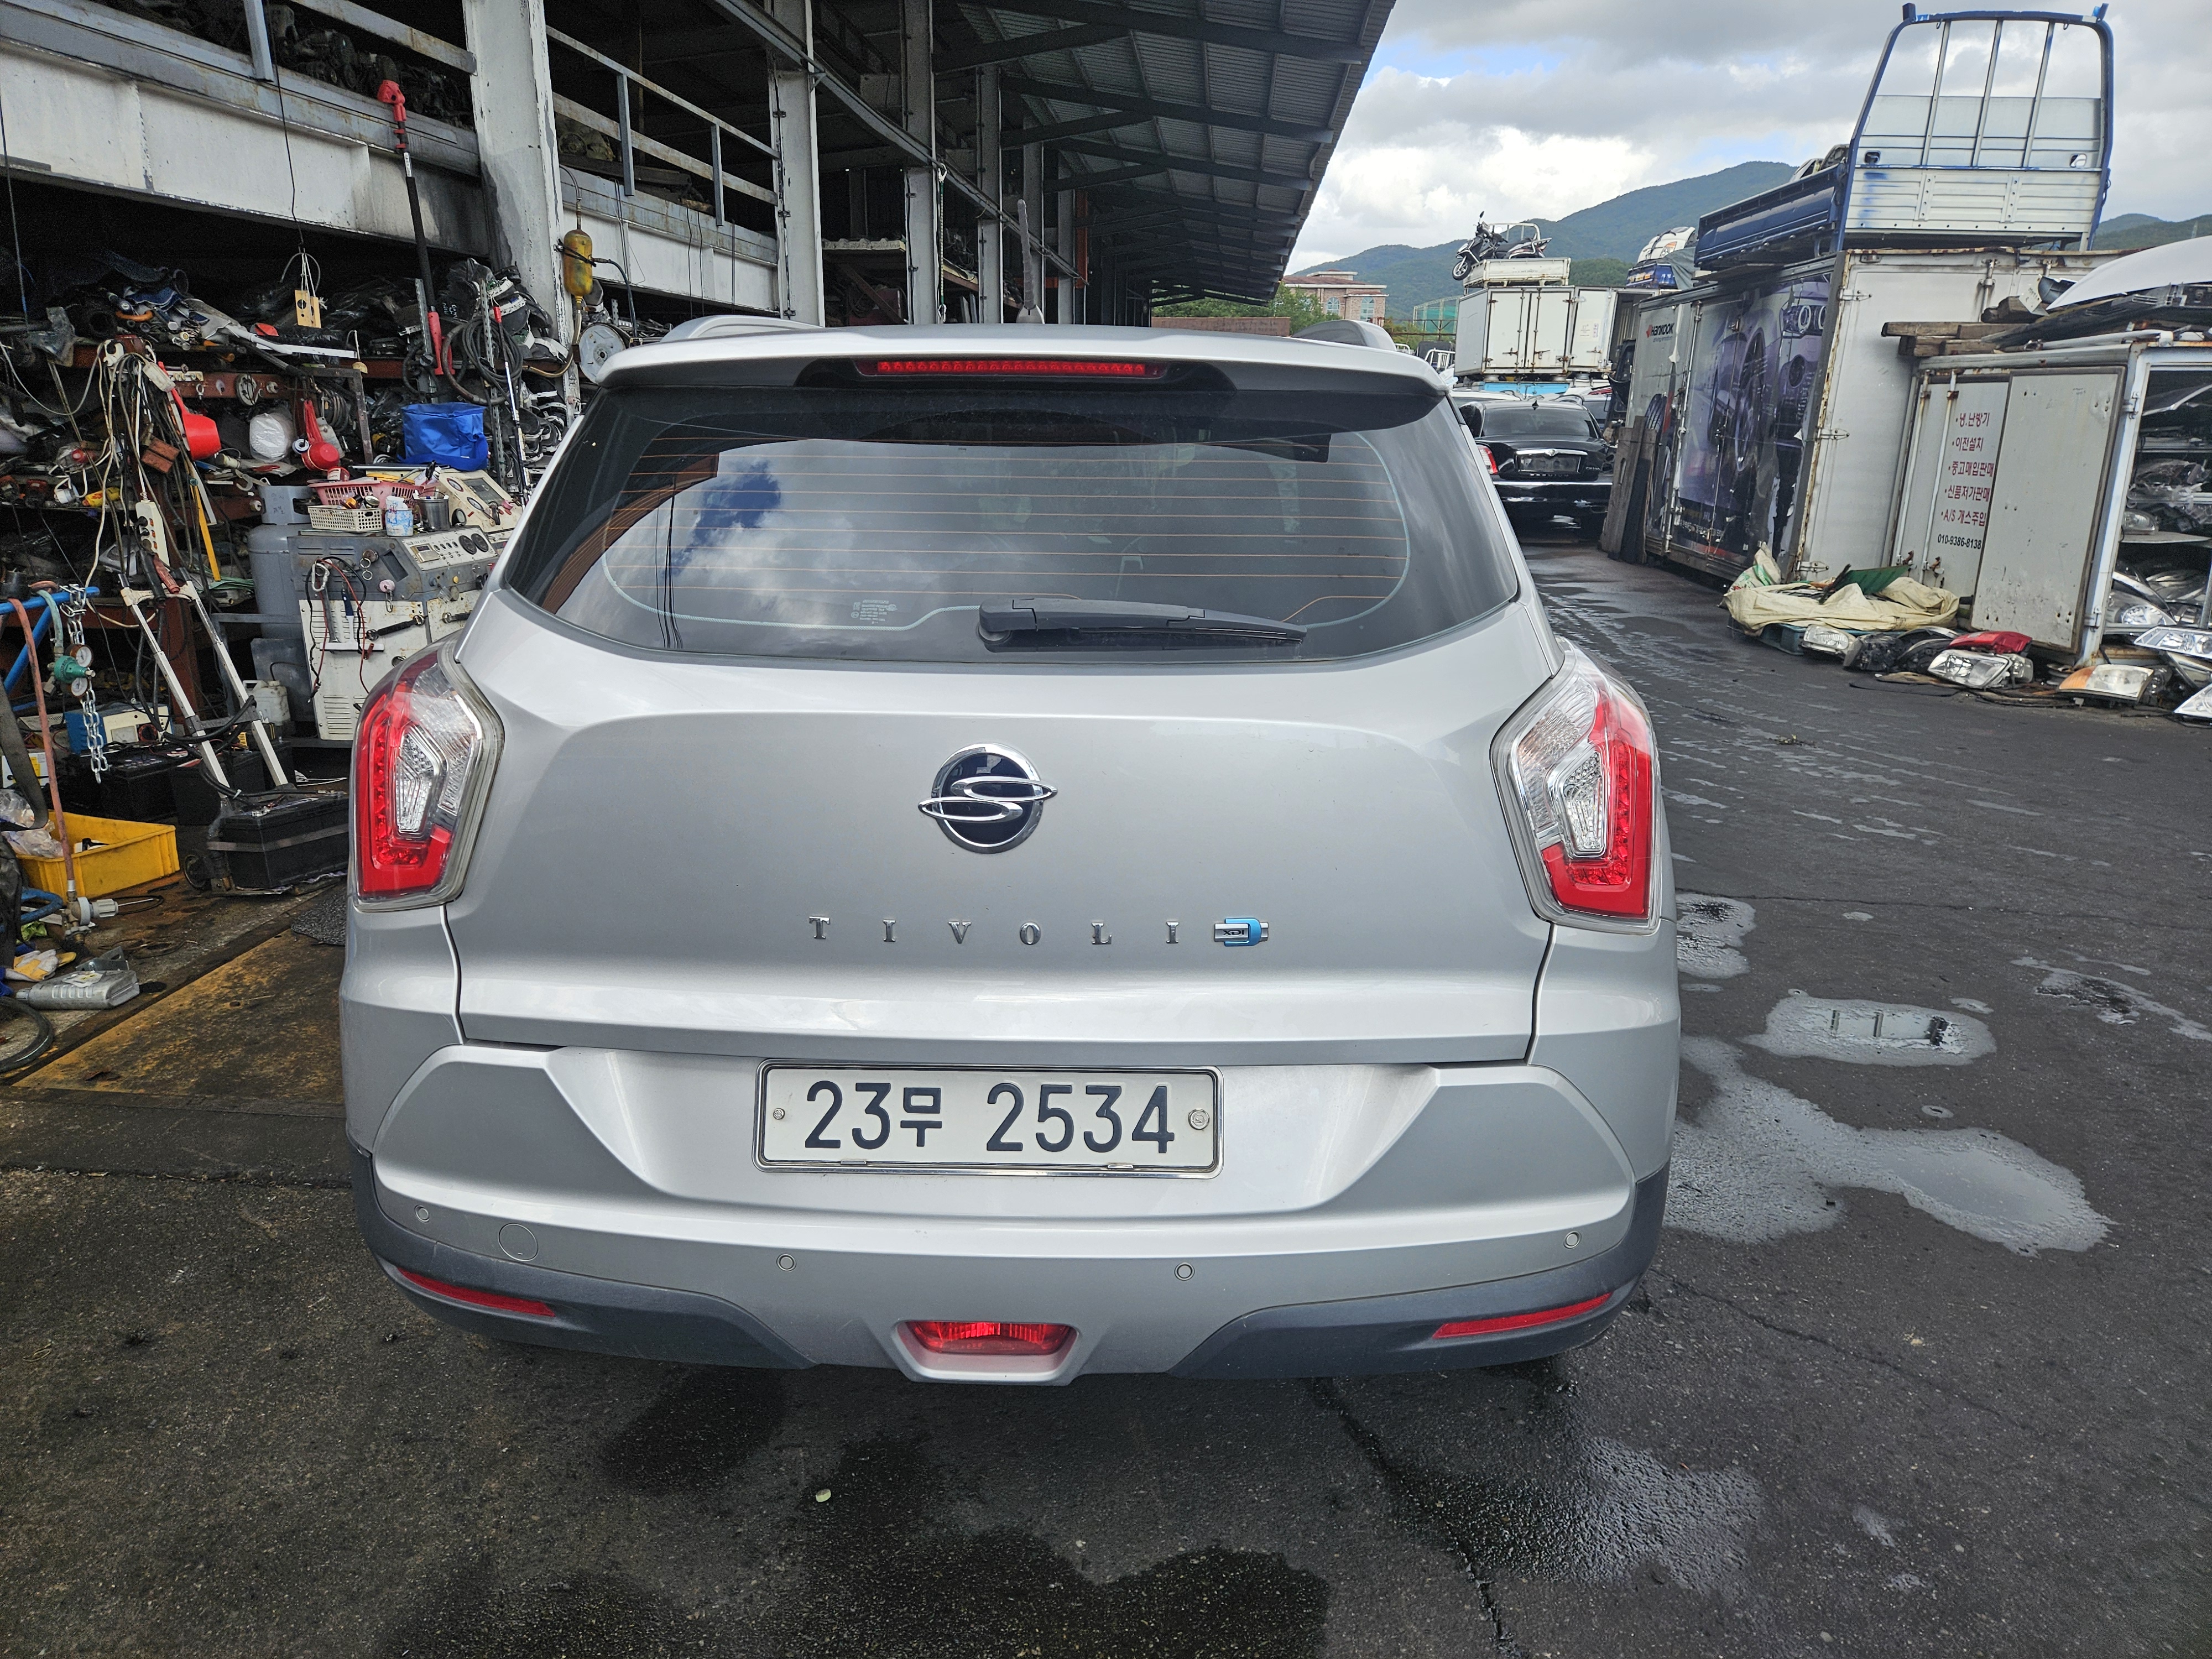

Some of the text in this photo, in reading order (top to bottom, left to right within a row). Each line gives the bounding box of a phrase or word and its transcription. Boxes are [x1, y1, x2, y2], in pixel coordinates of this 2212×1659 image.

[1955, 437, 1984, 451] 이전설치
[1952, 461, 1995, 477] 중고매입판매
[1948, 484, 1990, 502] 신품저가판매
[1943, 509, 1986, 526] A/S 개스주입
[1938, 534, 1982, 549] 010-9386-8138
[809, 916, 1180, 945] TIVOLI
[805, 1080, 1175, 1154] 23무 2534
